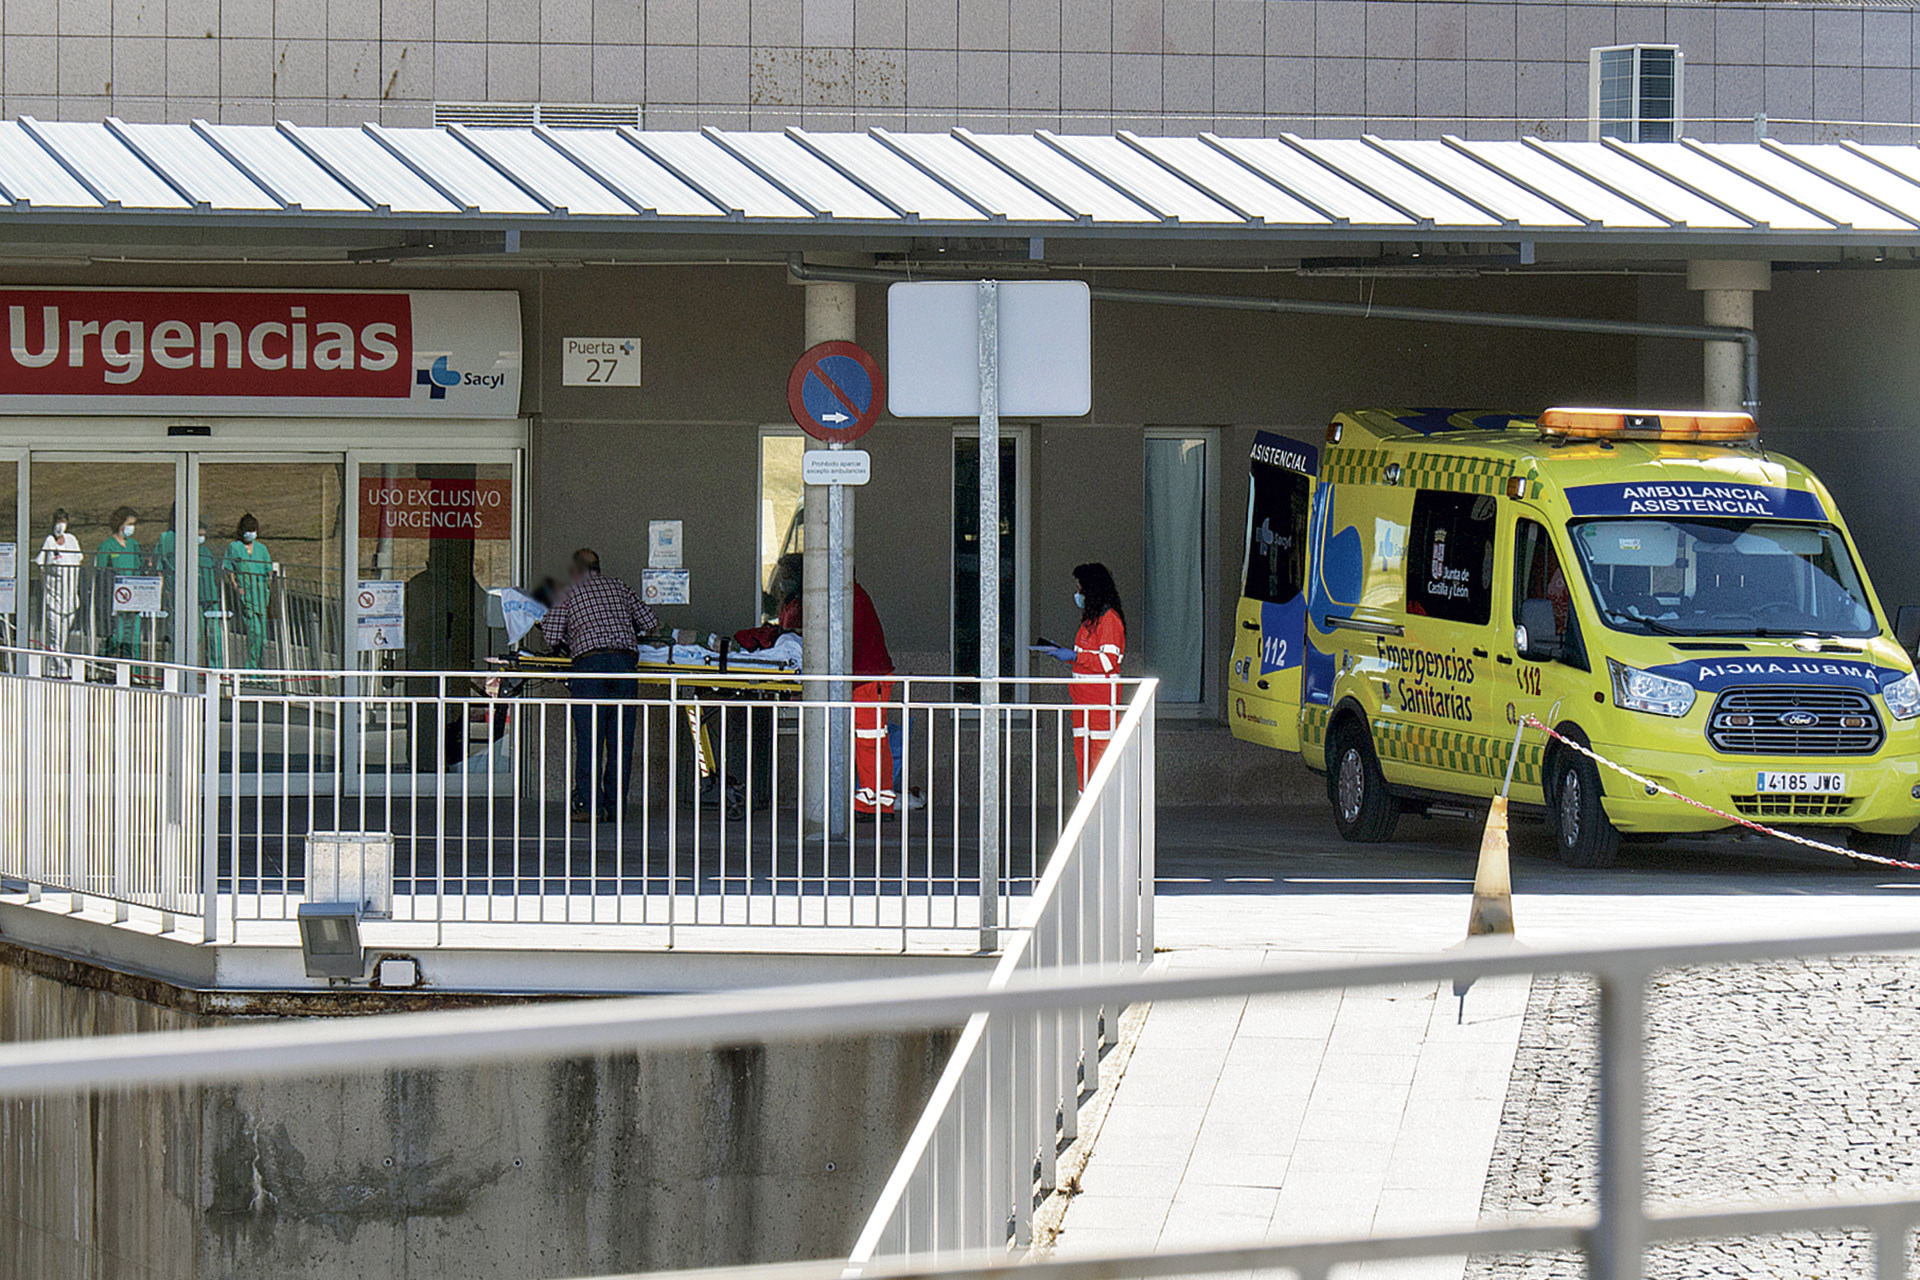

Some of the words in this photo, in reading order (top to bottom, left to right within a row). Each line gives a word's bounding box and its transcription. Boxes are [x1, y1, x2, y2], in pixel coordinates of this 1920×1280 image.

[9, 305, 399, 385] Urgencias
[568, 341, 615, 355] Puerta
[586, 358, 618, 383] 27
[463, 372, 504, 389] Sacyl
[1250, 443, 1307, 472] ASISTENCIAL
[368, 489, 403, 506] USO
[408, 489, 501, 508] EXCLUSIVO
[1623, 486, 1769, 503] AMBULANCIA
[1630, 500, 1773, 516] ASISTENCIAL
[386, 511, 483, 528] URGENCIAS
[1443, 566, 1461, 580] Junta
[1461, 568, 1470, 581] de
[1427, 581, 1448, 595] Castilla
[1453, 583, 1469, 597] León
[1264, 636, 1287, 667] 112
[1377, 636, 1475, 684] Emergencias
[1523, 665, 1541, 696] 112
[1398, 678, 1472, 721] Sanitarias
[1790, 715, 1811, 724] Ford
[1769, 775, 1807, 790] 4185
[1813, 775, 1840, 790] JWG
